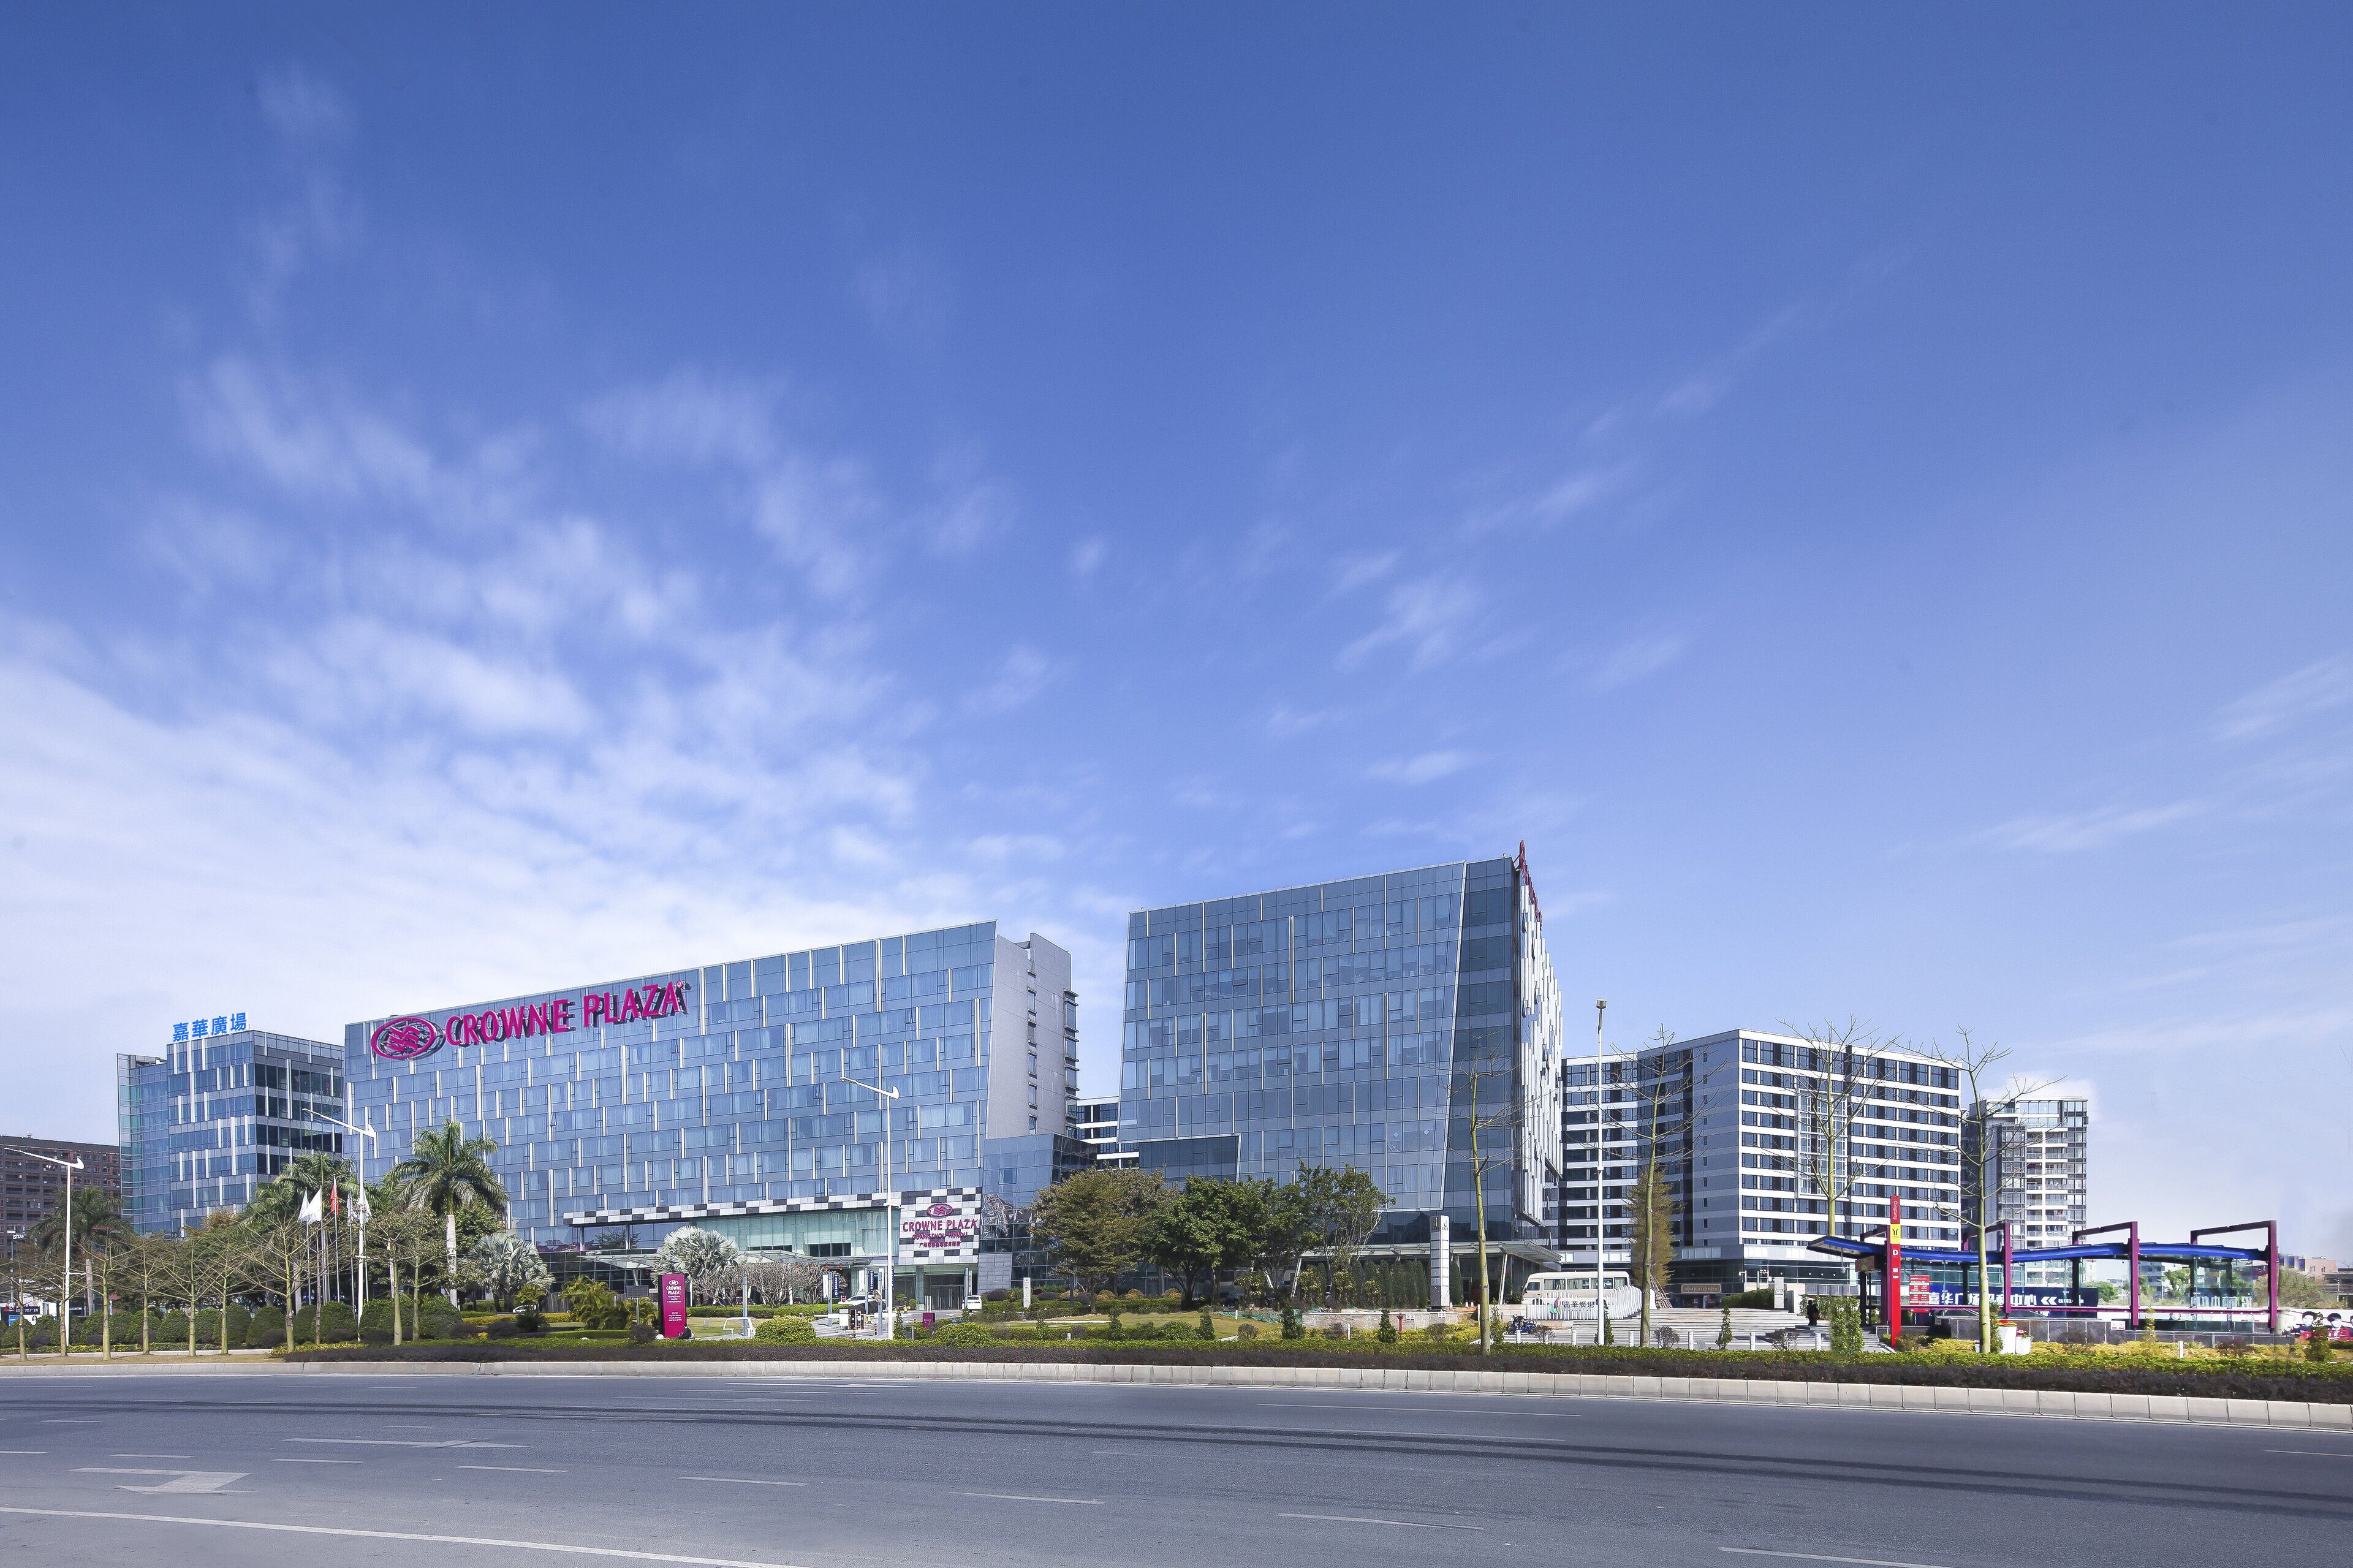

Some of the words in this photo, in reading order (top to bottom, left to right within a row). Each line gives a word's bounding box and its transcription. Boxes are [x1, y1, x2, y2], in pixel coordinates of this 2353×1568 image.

[173, 1012, 246, 1042] 嘉華廣場
[446, 999, 569, 1047] CROWNE
[583, 982, 680, 1028] PLAZA
[903, 1221, 942, 1232] CROWNE
[946, 1218, 977, 1231] PLAZA
